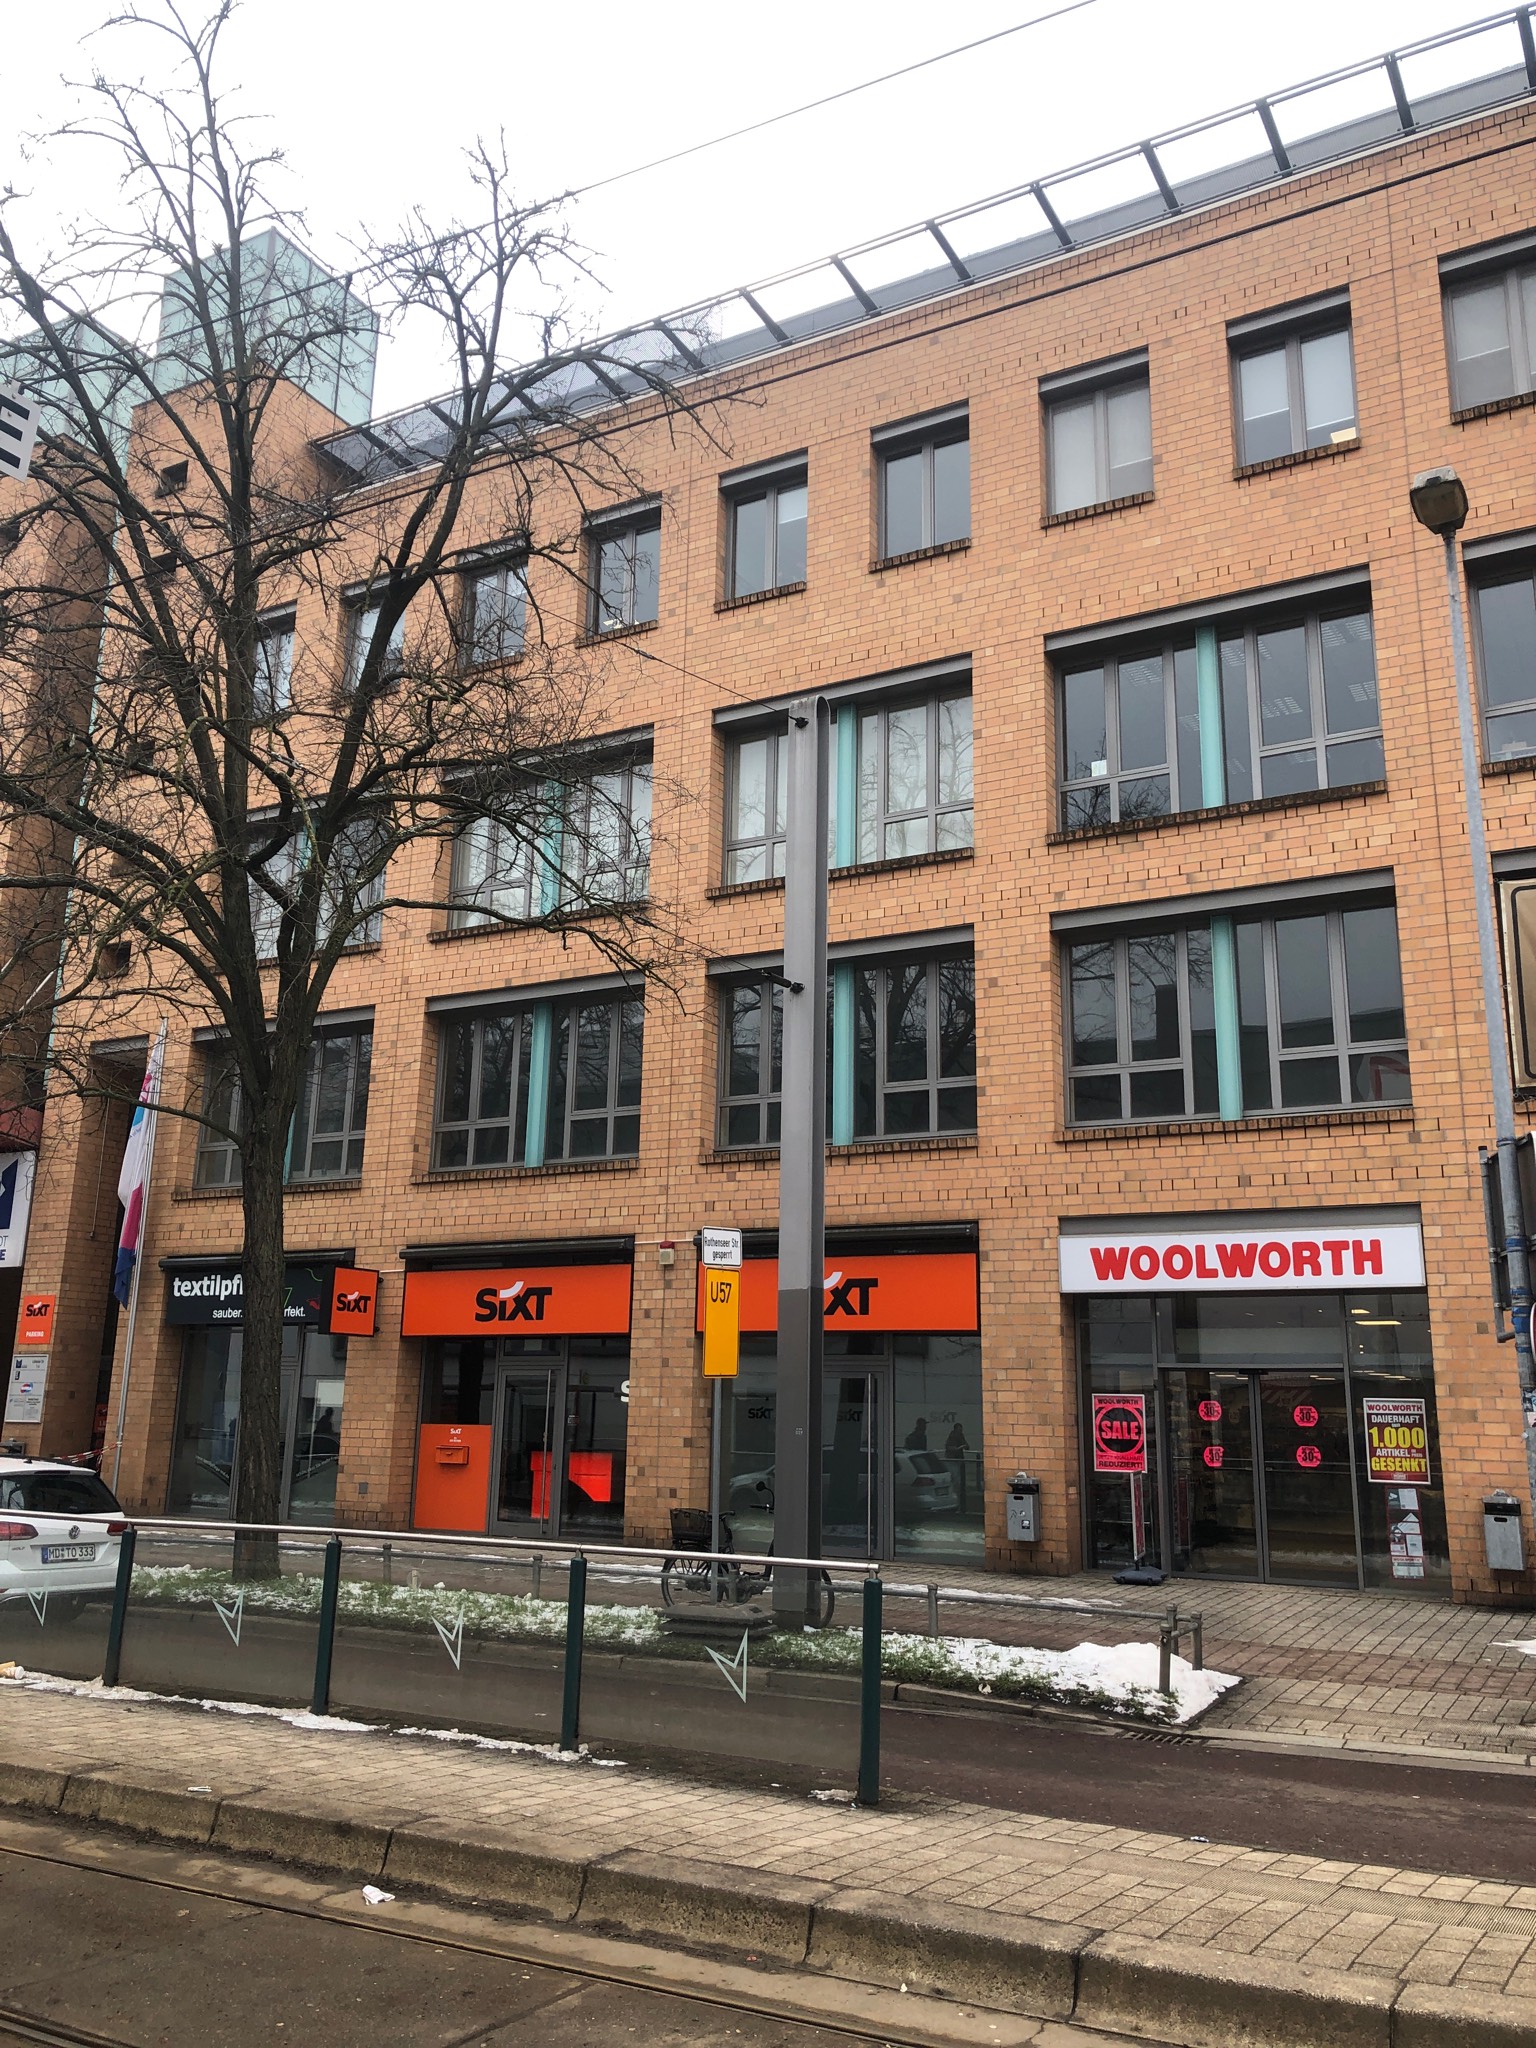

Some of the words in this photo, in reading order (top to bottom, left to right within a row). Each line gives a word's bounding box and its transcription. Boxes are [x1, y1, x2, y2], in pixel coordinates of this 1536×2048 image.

[712, 1250, 733, 1261] gesperrt
[1089, 1239, 1383, 1281] WOOLWORTH
[212, 1307, 243, 1319] sauber.
[1367, 1404, 1423, 1412] WOOLWORTH
[1371, 1415, 1420, 1423] DAUERHAFT
[1101, 1420, 1140, 1440] SALE
[1368, 1426, 1425, 1449] 1.000
[1376, 1448, 1411, 1457] ARTIKEL
[1098, 1460, 1143, 1469] REDUZIERT!
[1371, 1457, 1427, 1472] GESENKT
